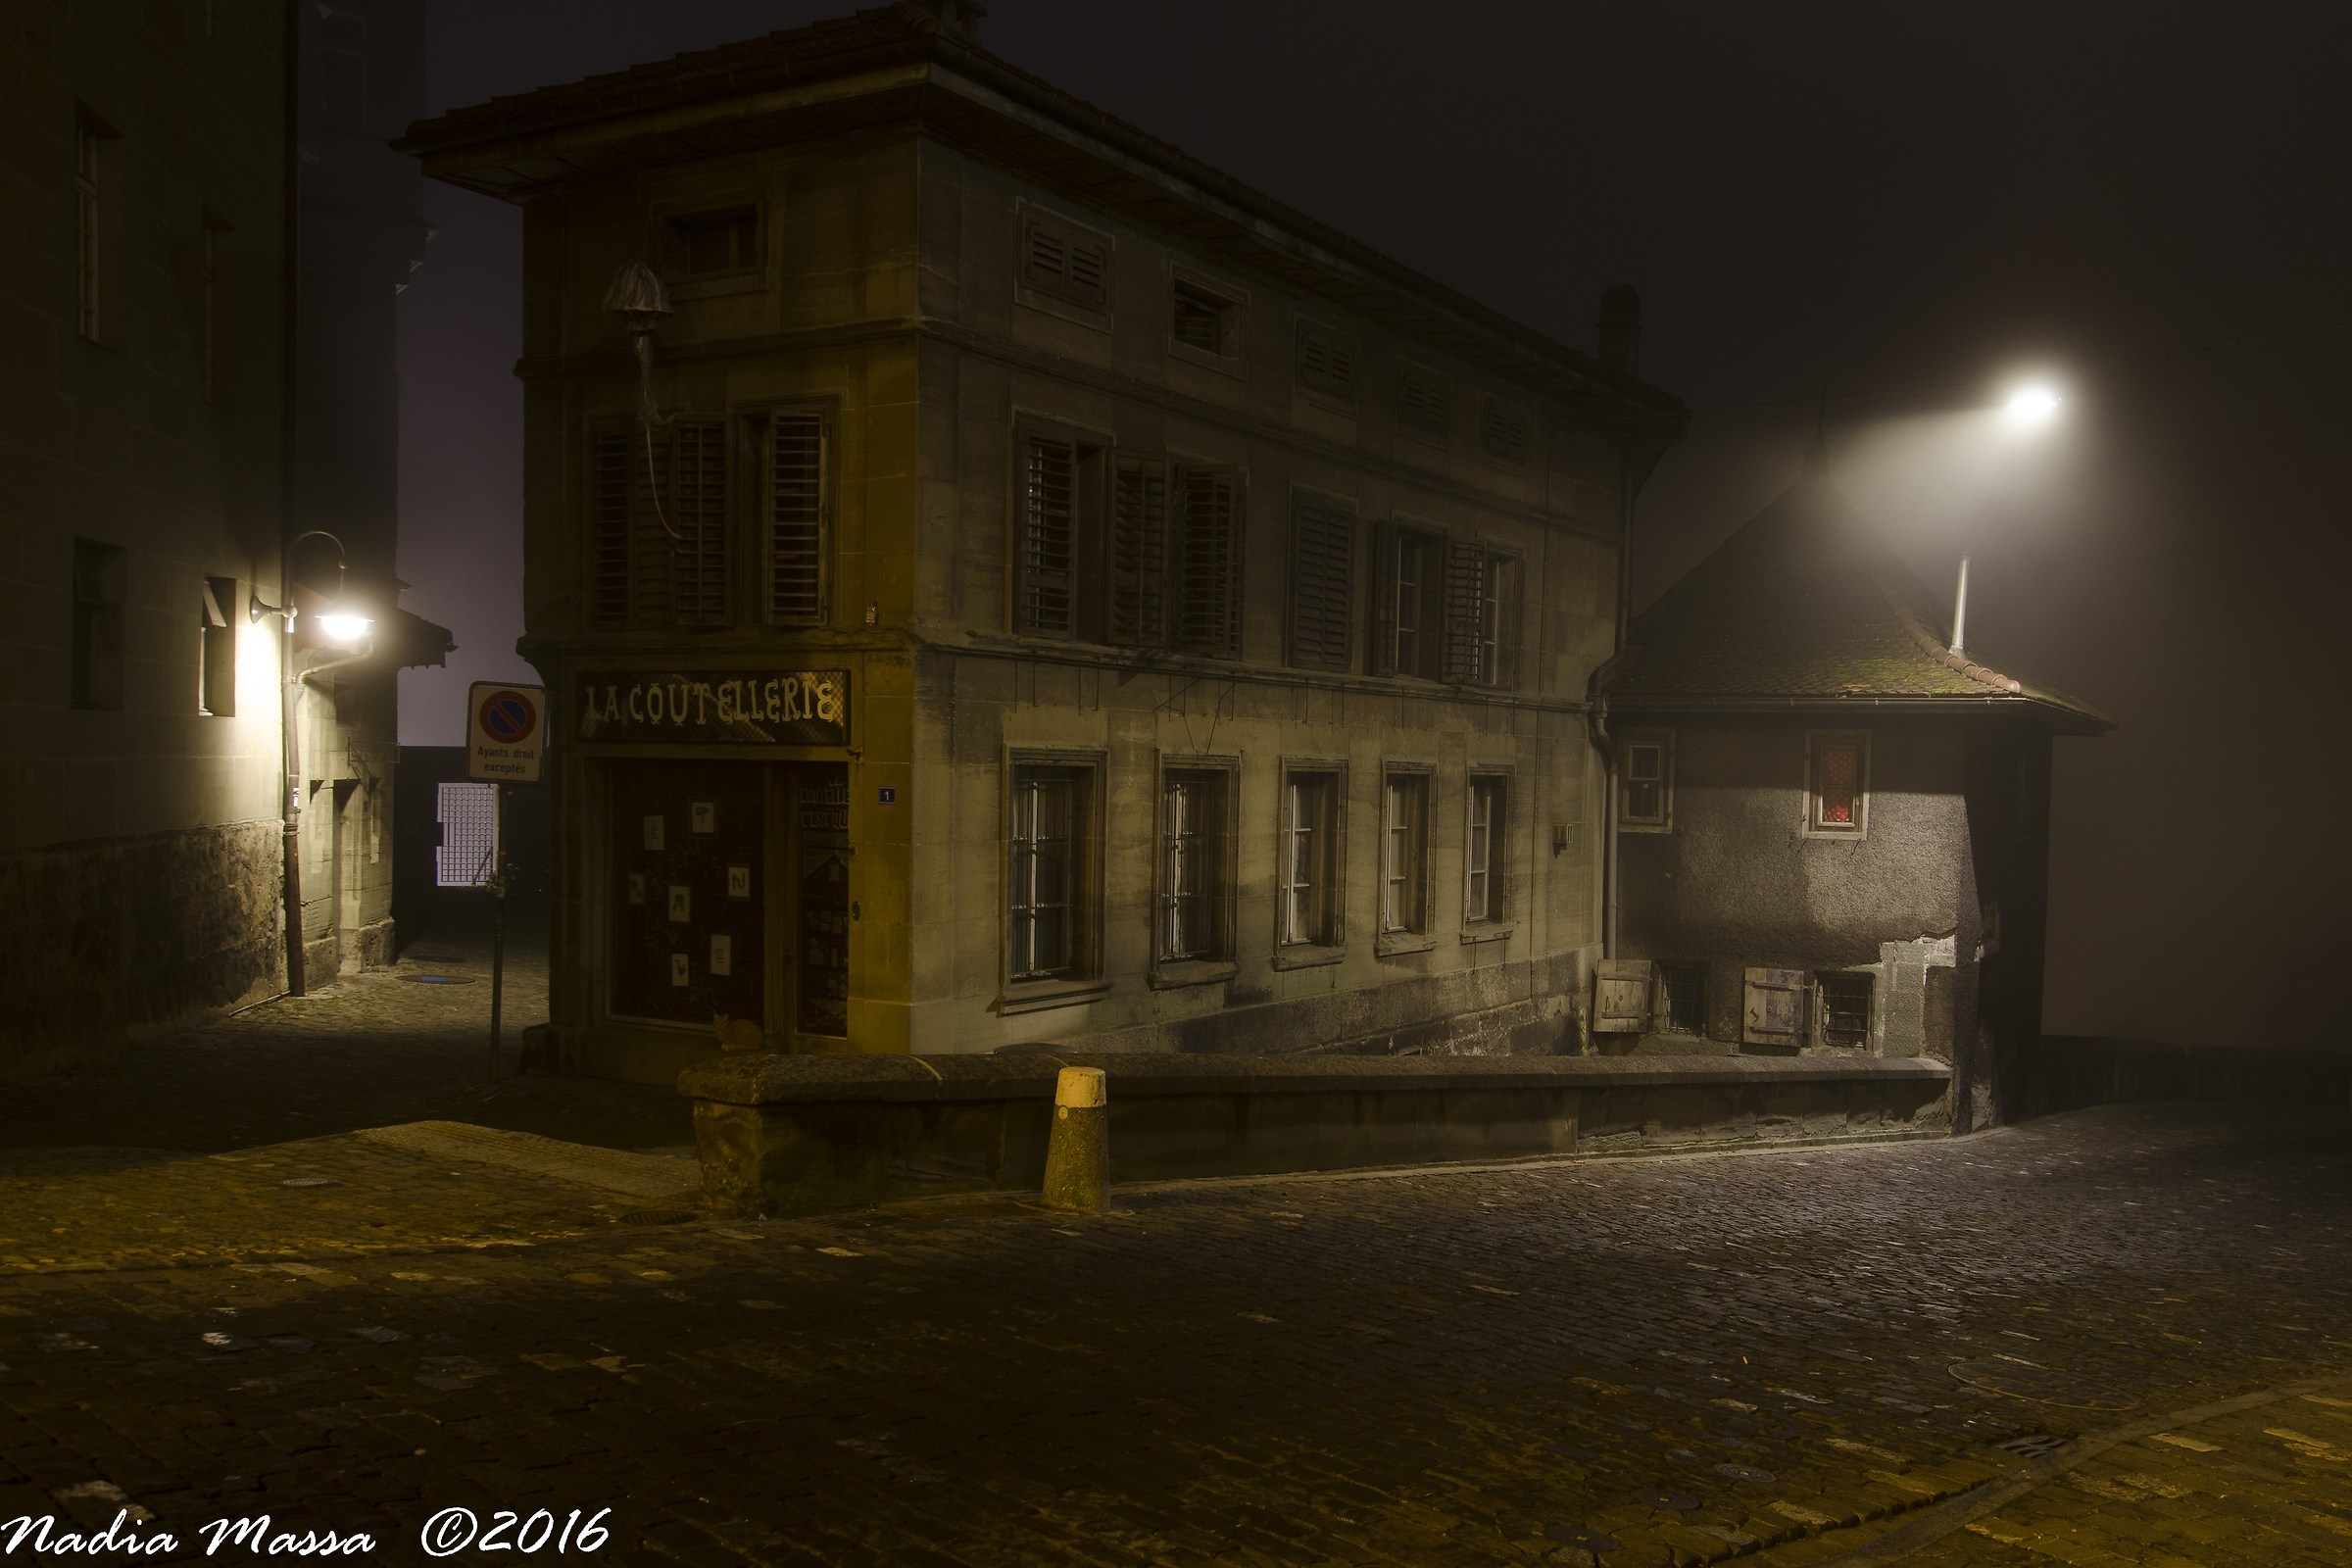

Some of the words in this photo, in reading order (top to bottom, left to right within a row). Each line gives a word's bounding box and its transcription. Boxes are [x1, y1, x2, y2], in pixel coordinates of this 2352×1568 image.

[585, 685, 620, 722] LA
[628, 676, 835, 726] COUTELLERIE
[477, 745, 509, 759] Ayants
[514, 748, 534, 760] droit
[485, 763, 526, 775] exceptés
